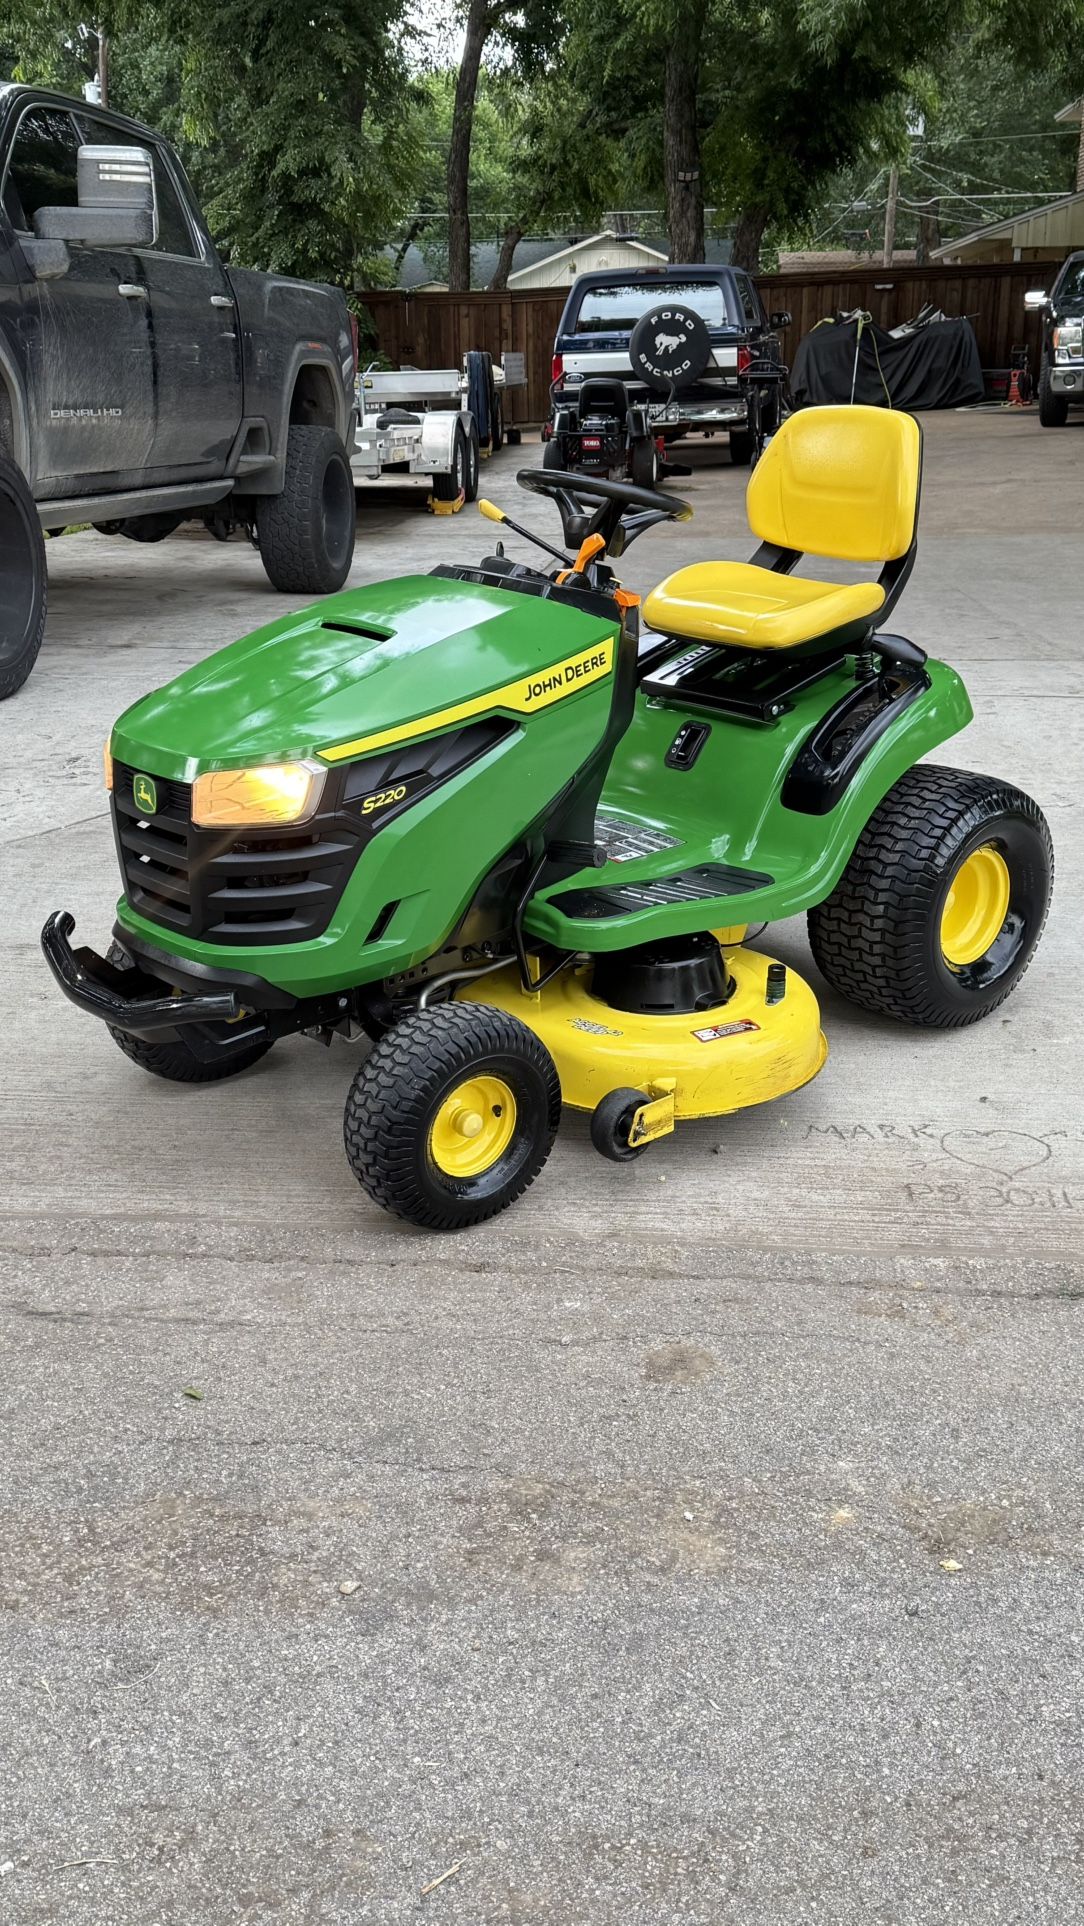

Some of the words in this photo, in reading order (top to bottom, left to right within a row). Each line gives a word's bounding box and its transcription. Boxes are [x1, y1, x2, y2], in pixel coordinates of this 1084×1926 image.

[651, 312, 694, 330] FORD
[51, 408, 101, 418] DENALI
[103, 408, 122, 417] HD
[525, 673, 562, 701] JOHN
[564, 652, 607, 683] DEERE
[361, 786, 406, 814] S220
[802, 1122, 936, 1140] MARK
